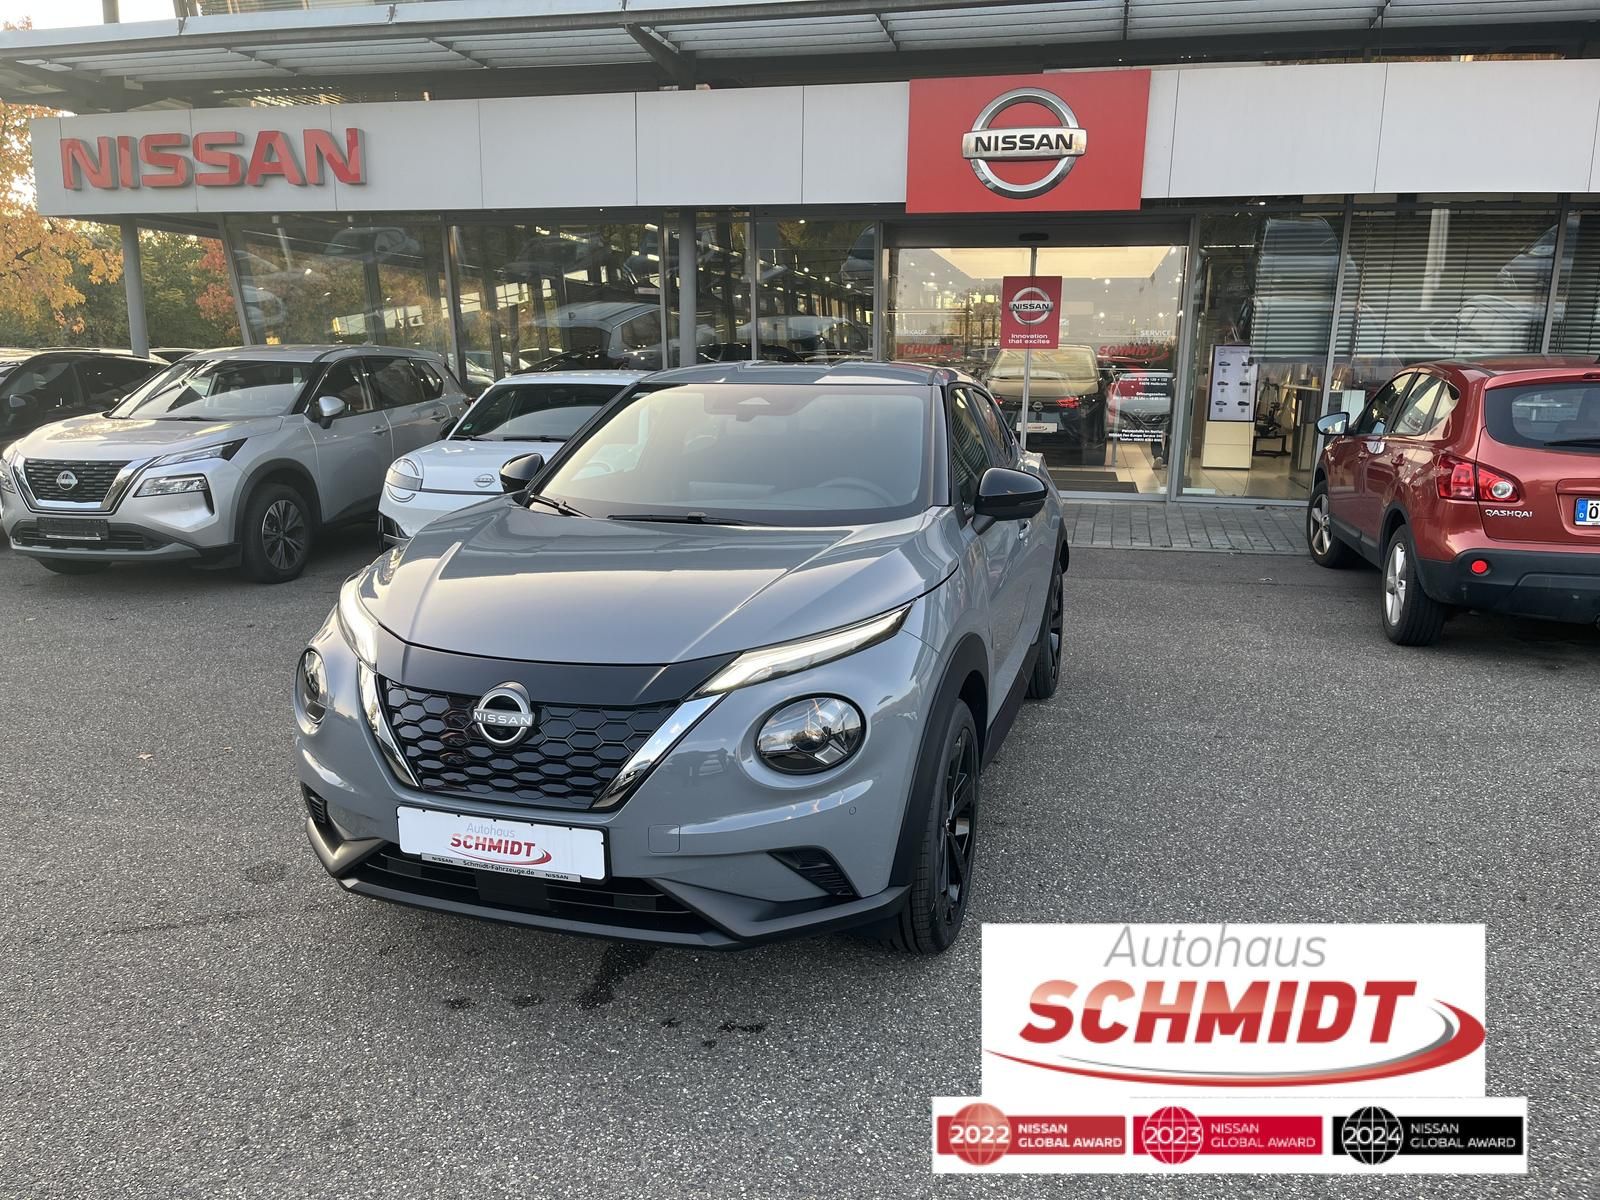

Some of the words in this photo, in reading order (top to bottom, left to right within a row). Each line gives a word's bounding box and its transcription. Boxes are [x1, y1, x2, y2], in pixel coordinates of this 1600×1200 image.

[975, 134, 1074, 152] NISSAN
[60, 128, 367, 190] NISSAN
[1140, 329, 1172, 337] SERVICE
[1097, 343, 1157, 356] SCHMIDT
[1485, 509, 1533, 518] QASHQAI
[473, 711, 531, 725] NISSAN
[466, 822, 516, 838] Autohaus
[450, 833, 536, 857] SCHMIDT
[431, 856, 454, 864] NISSAN
[462, 860, 535, 876] Schmidt-Fahrzeuge.de
[545, 872, 569, 880] NISSAN
